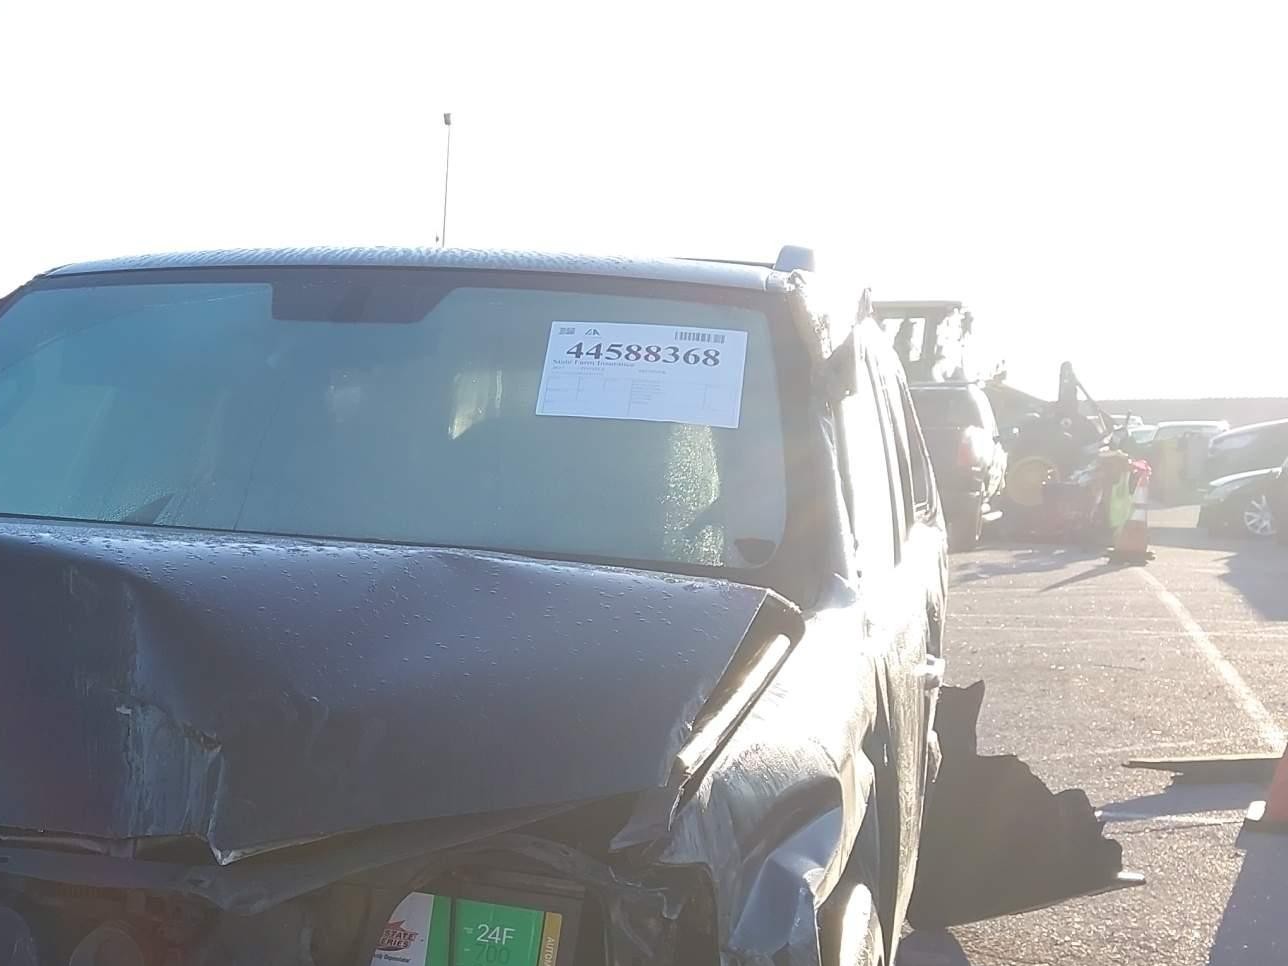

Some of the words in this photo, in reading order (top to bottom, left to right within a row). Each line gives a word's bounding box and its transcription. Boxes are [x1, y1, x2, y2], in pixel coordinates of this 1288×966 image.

[566, 342, 721, 367] 44588368
[476, 923, 516, 945] 24F
[473, 945, 511, 965] 700
